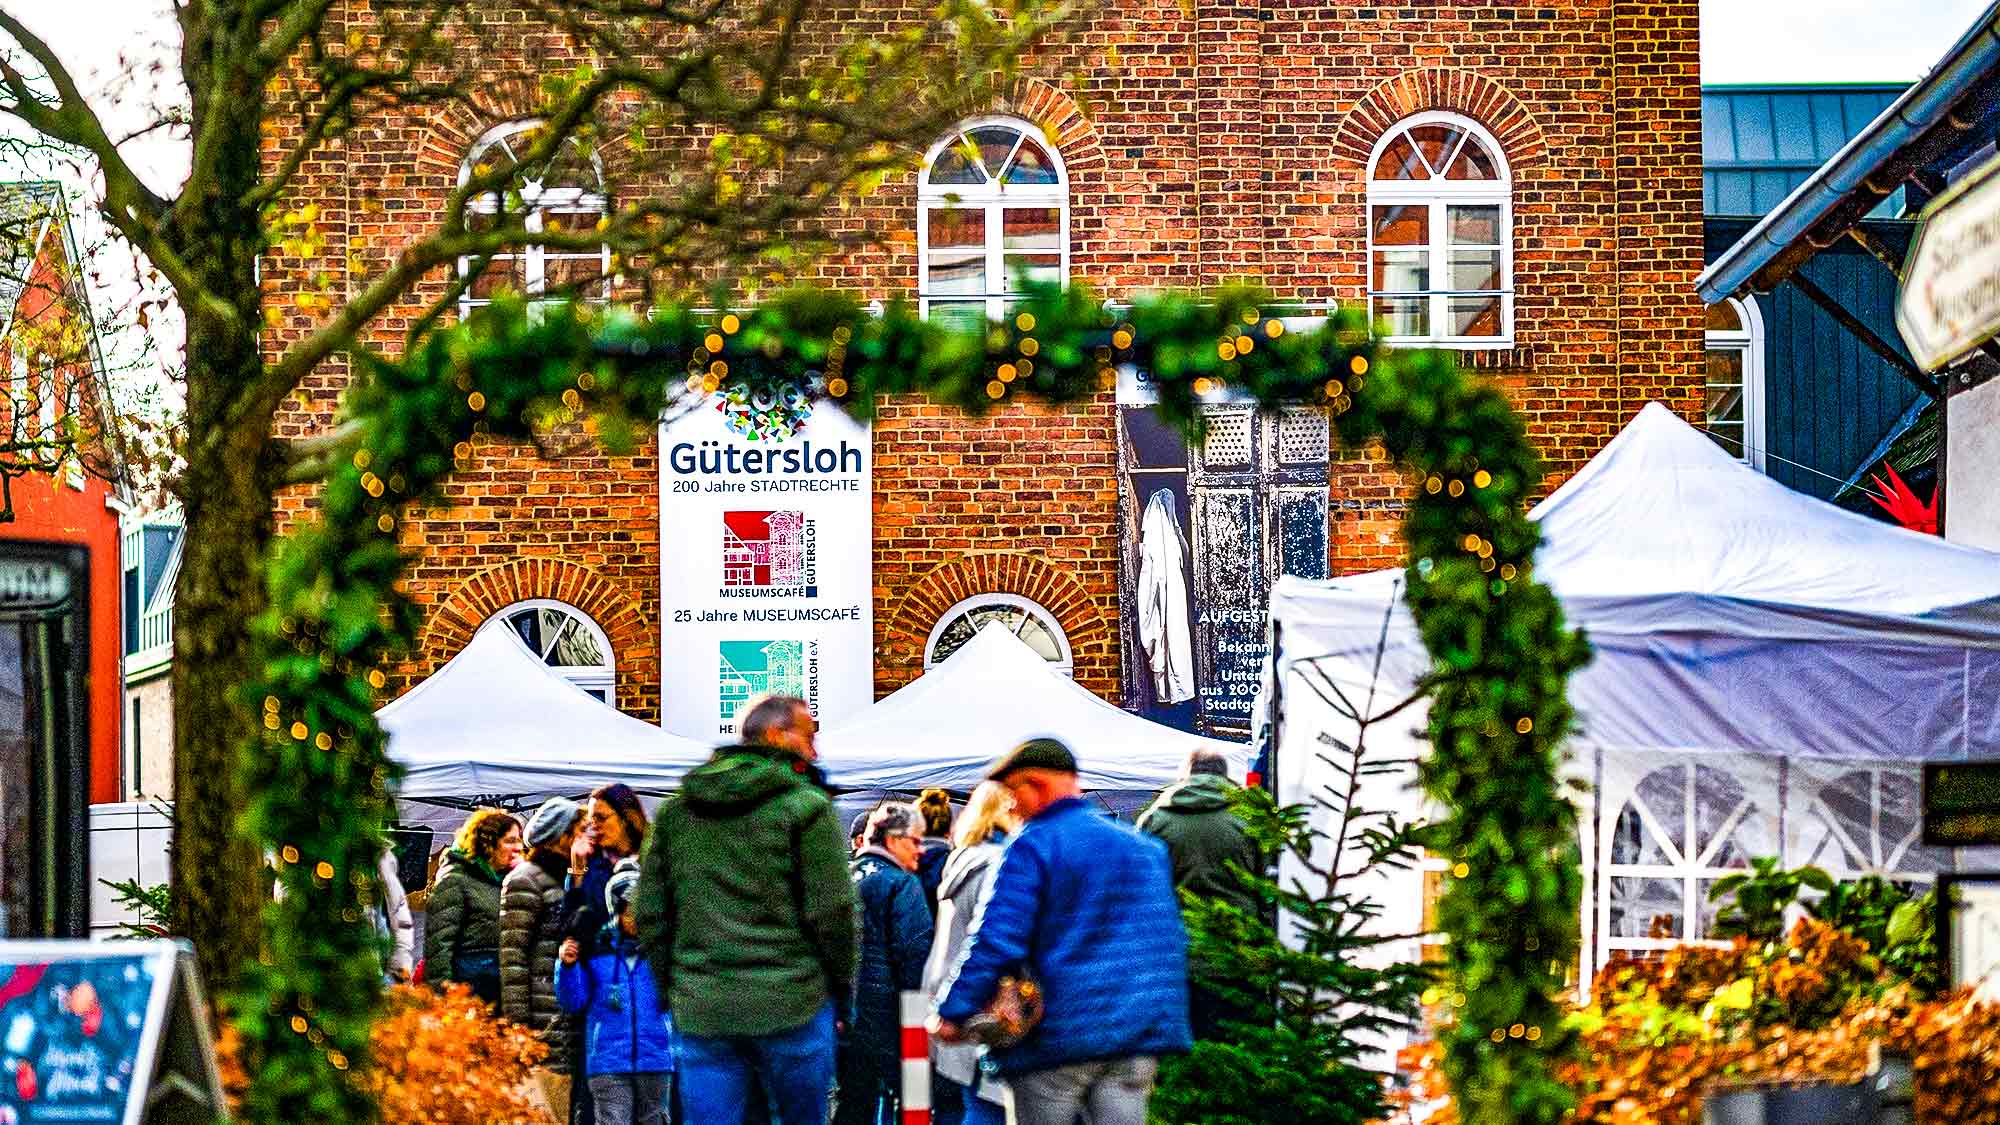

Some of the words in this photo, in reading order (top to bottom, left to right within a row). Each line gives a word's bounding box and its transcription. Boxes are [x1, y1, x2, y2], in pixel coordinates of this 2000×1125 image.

[670, 440, 862, 475] Gütersloh
[673, 480, 699, 493] 200
[704, 480, 746, 493] Jahre
[750, 479, 860, 493] STADTRECHTE
[805, 518, 816, 585] GÜTERSLOH
[719, 586, 805, 598] MUSEUMSCAFÉ
[674, 609, 692, 623] 25
[696, 609, 738, 622] Jahre
[743, 605, 861, 622] MUSEUMSCAFÉ
[1199, 609, 1269, 623] AUFGEST
[809, 637, 819, 656] e.V.
[1218, 640, 1271, 653] Bekann
[808, 658, 819, 718] GÜTERSLOH
[1199, 686, 1224, 696] aus
[1229, 683, 1261, 696] 200
